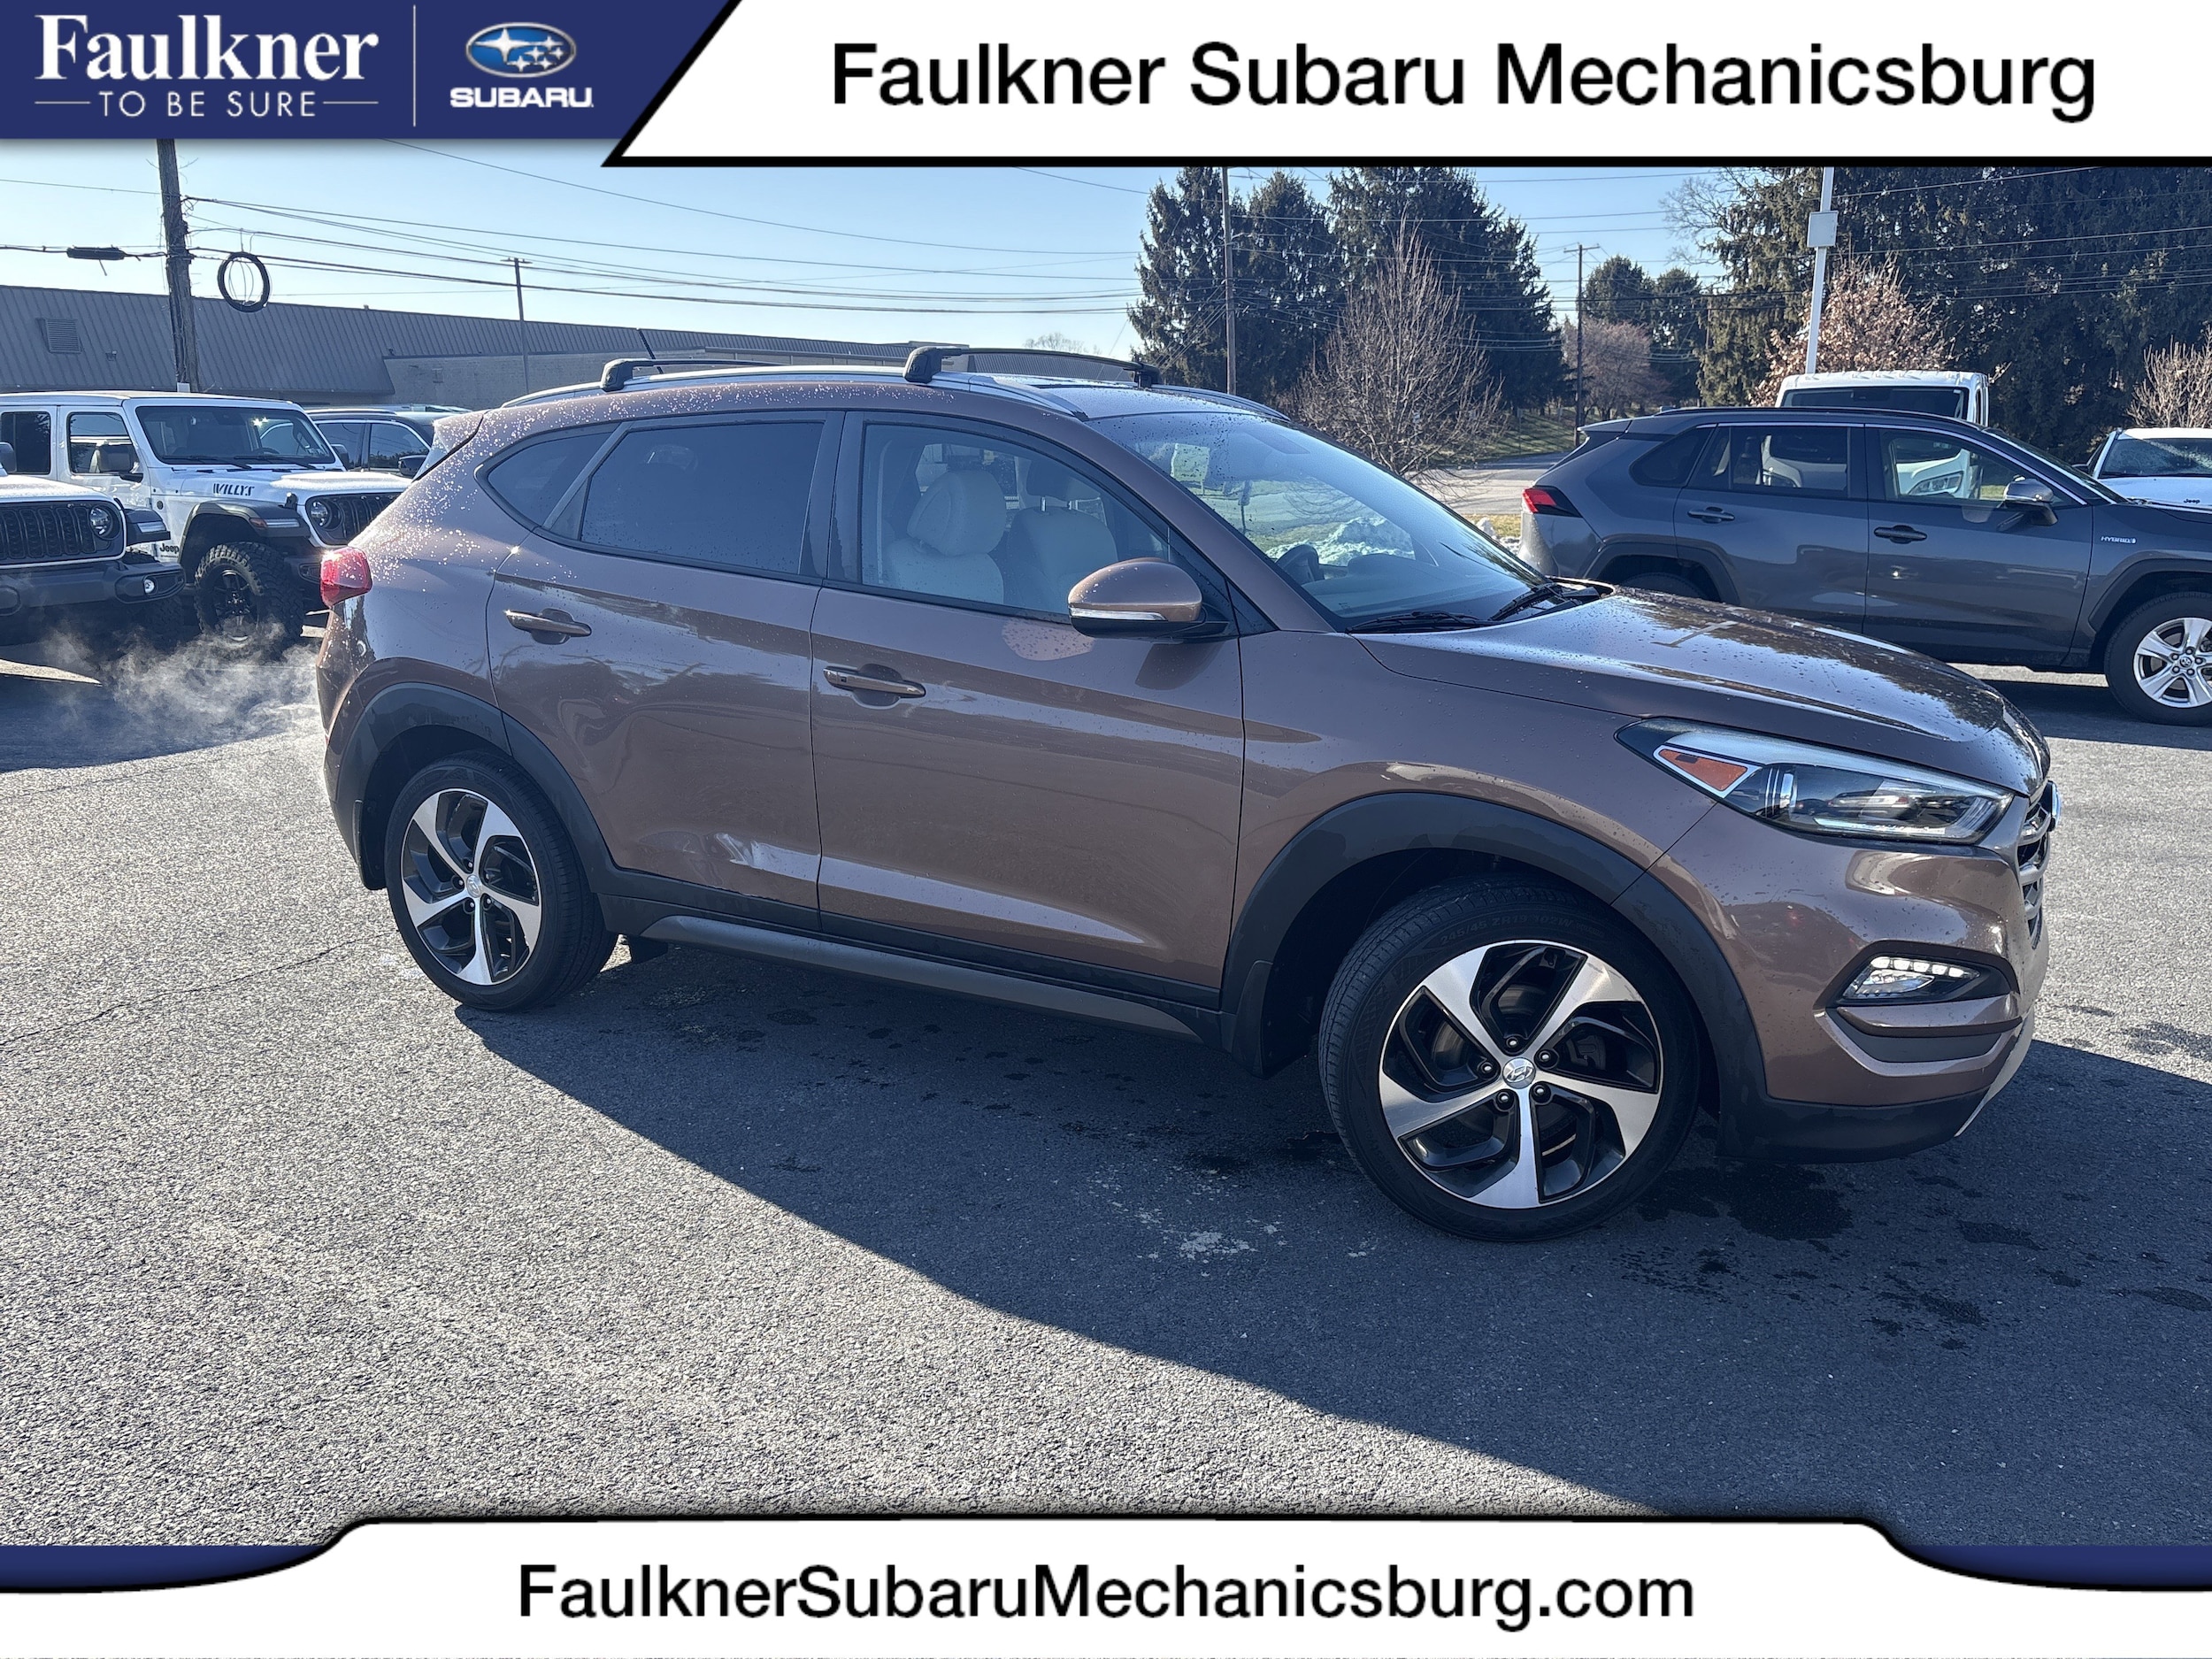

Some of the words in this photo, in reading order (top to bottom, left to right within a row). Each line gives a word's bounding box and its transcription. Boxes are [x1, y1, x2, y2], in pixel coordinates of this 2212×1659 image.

[213, 483, 255, 496] WILLYS
[2101, 535, 2131, 544] HYBRID
[159, 542, 180, 555] Jeep
[1440, 919, 1487, 945] 245/45
[1492, 915, 1529, 927] ZR19
